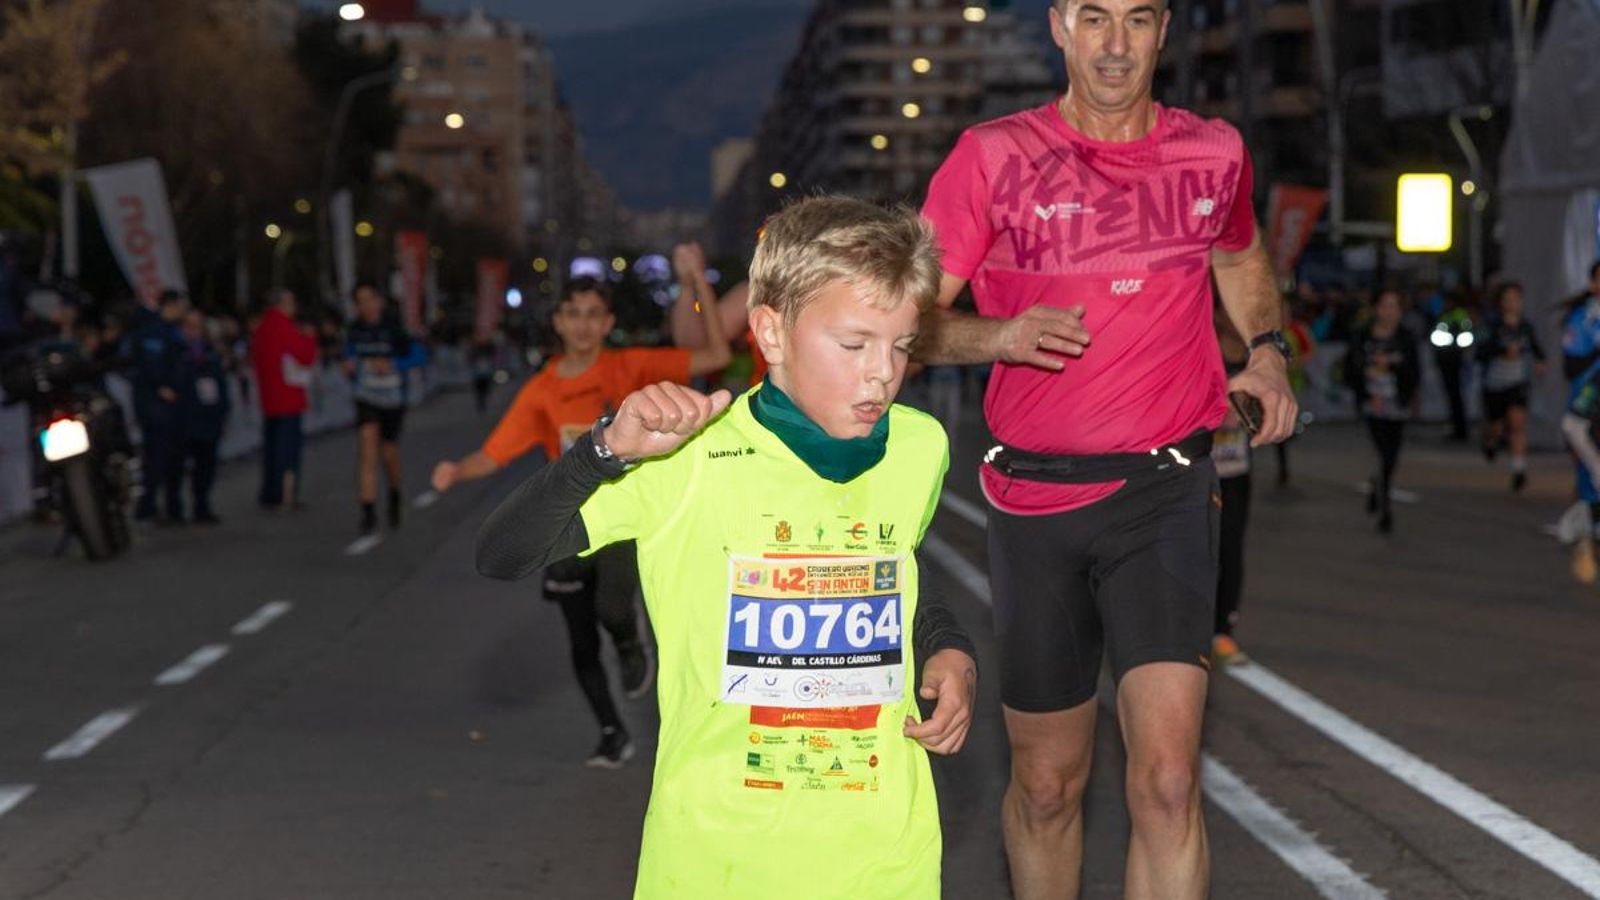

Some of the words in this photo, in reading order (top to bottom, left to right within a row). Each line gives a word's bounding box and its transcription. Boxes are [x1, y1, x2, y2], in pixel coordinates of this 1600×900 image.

[708, 447, 743, 459] luanvi
[772, 567, 806, 591] 42
[735, 599, 900, 650] 10764
[791, 656, 807, 665] DEL
[809, 656, 845, 665] CASTILLO
[846, 654, 882, 665] CÁRDENAS
